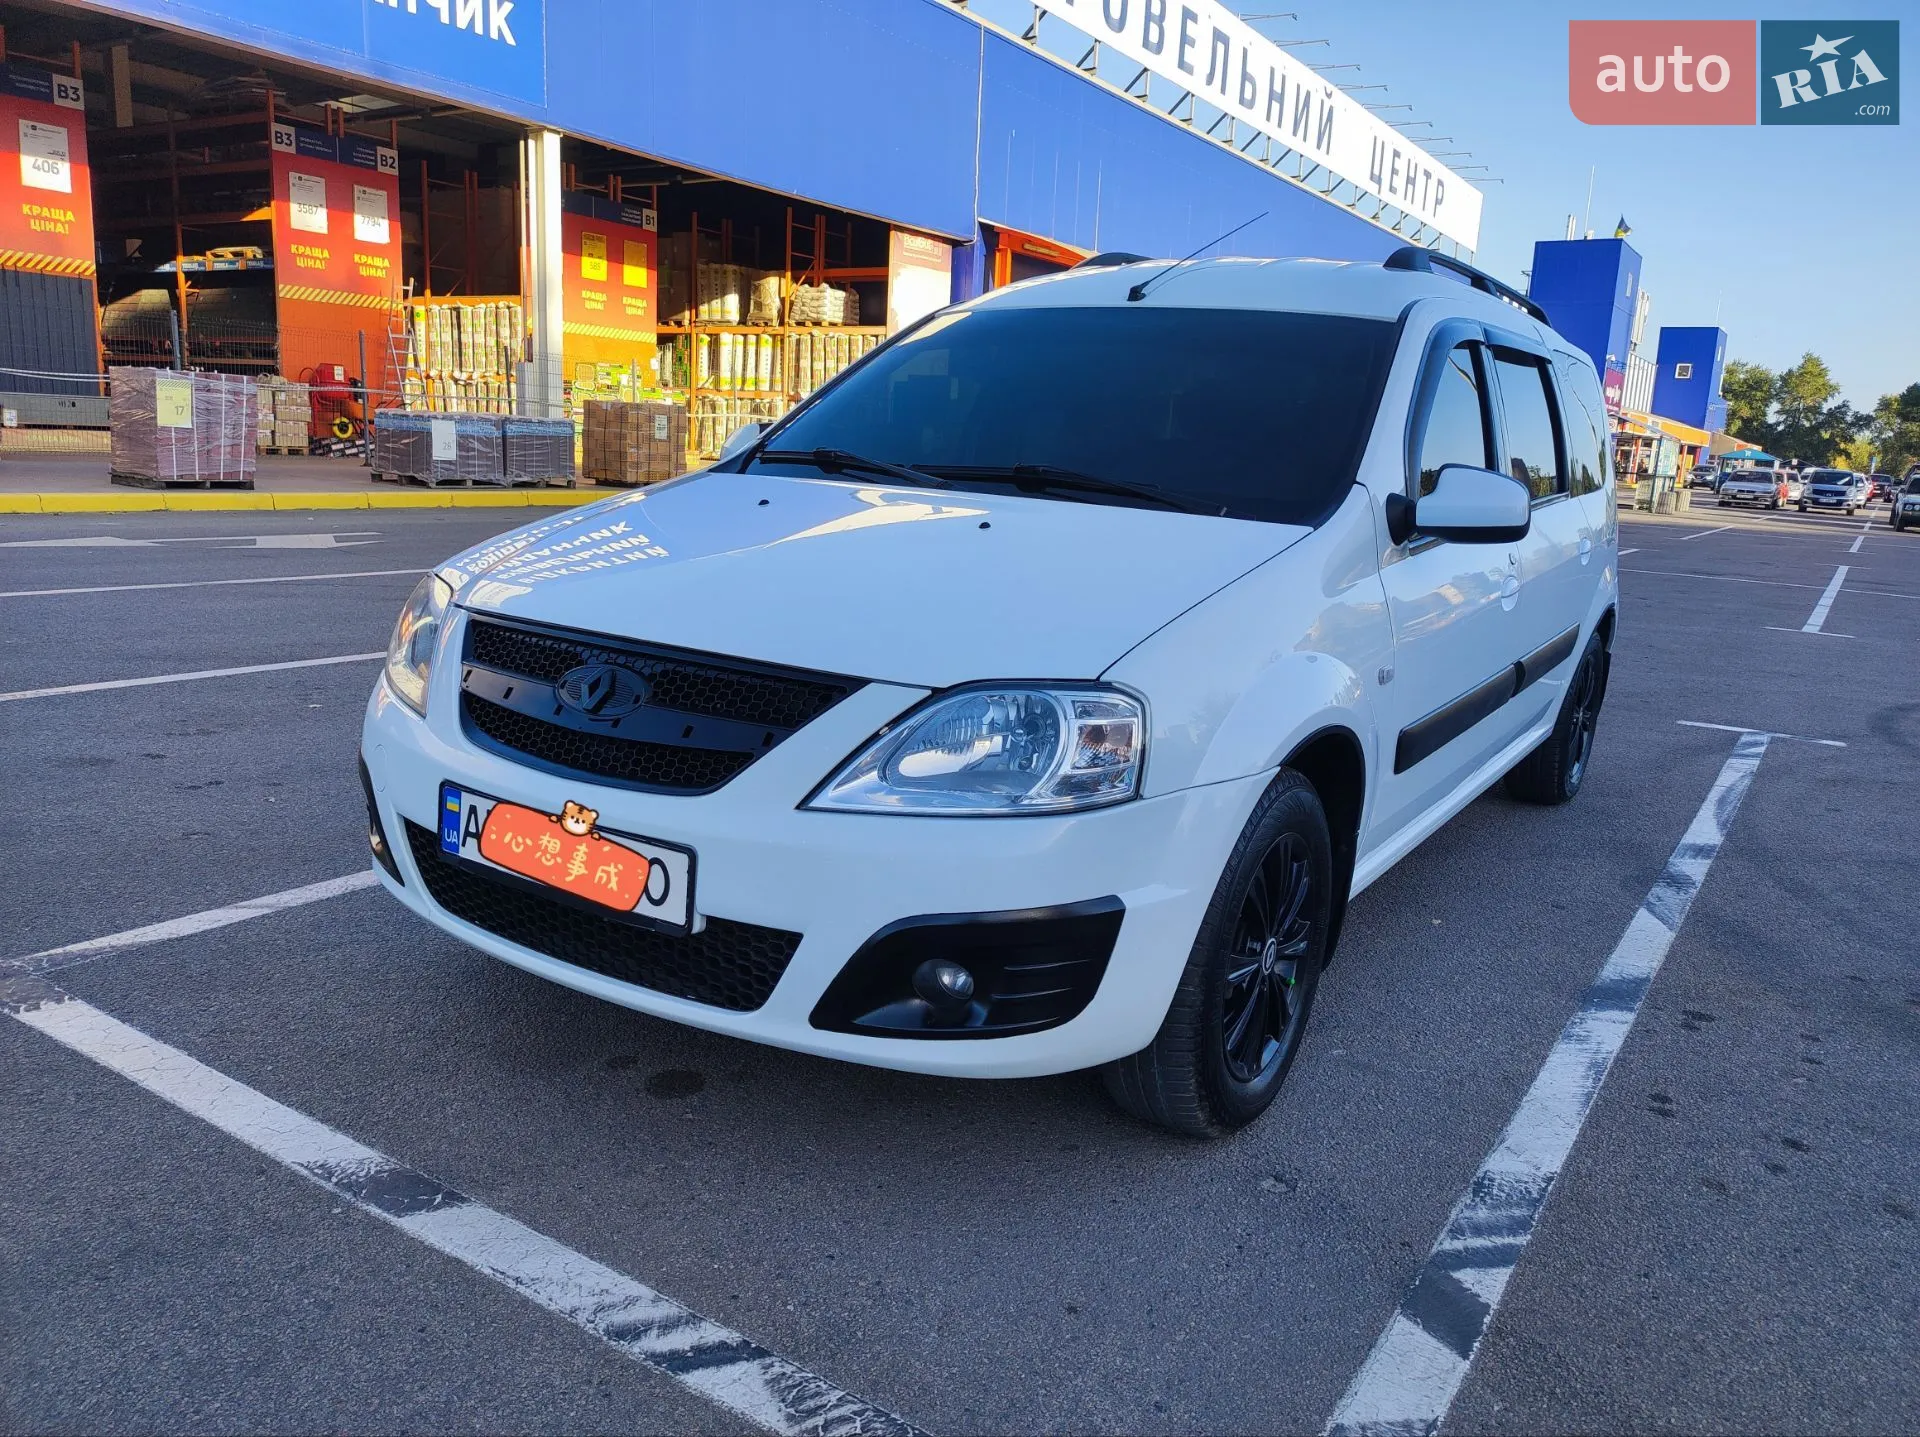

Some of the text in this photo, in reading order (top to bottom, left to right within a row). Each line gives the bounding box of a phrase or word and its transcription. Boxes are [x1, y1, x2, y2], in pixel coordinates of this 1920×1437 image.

[32, 157, 60, 175] 406
[1369, 135, 1445, 219] ЦЕНТР
[22, 203, 76, 222] КРАЩА
[296, 202, 319, 216] 3587
[30, 218, 69, 234] ЦІНА!
[290, 243, 330, 259] КРАЩА
[296, 256, 325, 270] ЦІНА!
[354, 253, 391, 268] КРАЩА
[359, 266, 386, 279] ЦІНА!
[174, 405, 185, 416] 17
[445, 828, 459, 845] UA
